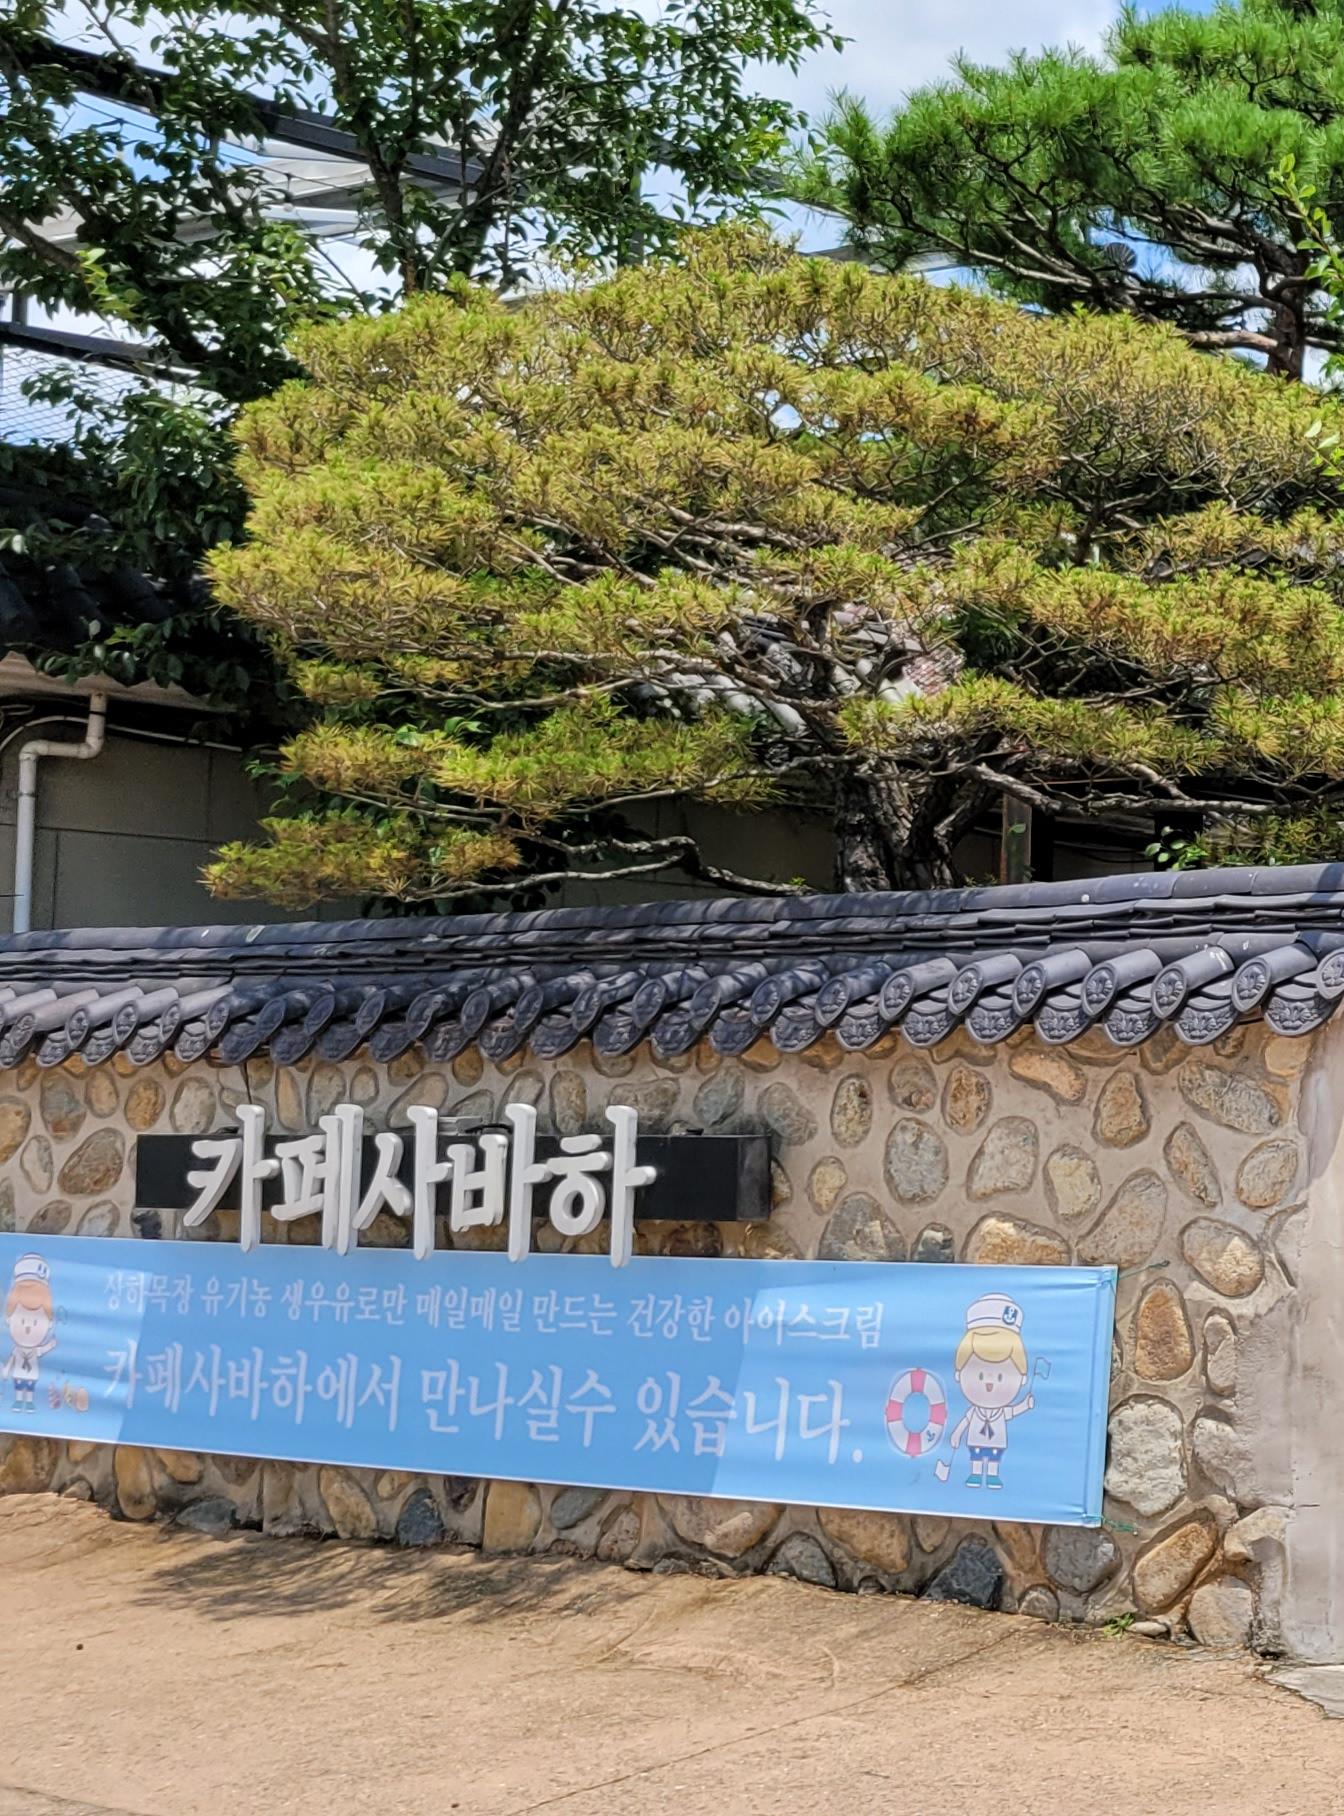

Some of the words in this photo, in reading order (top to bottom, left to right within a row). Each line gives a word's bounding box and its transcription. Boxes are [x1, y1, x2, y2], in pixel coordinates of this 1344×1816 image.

[183, 1102, 658, 1269] 카페사바하
[103, 1270, 194, 1315] 상하목장
[201, 1275, 273, 1318] 유기농
[281, 1279, 408, 1325] 생우유로만
[416, 1284, 523, 1333] 매일매일
[532, 1288, 618, 1335] 만드는
[627, 1293, 716, 1342] 건강한
[724, 1297, 884, 1350] 아이스크림
[103, 1339, 402, 1433] 카페사바하에서
[420, 1358, 617, 1448] 만나실수
[633, 1370, 864, 1465] 있습니다.
